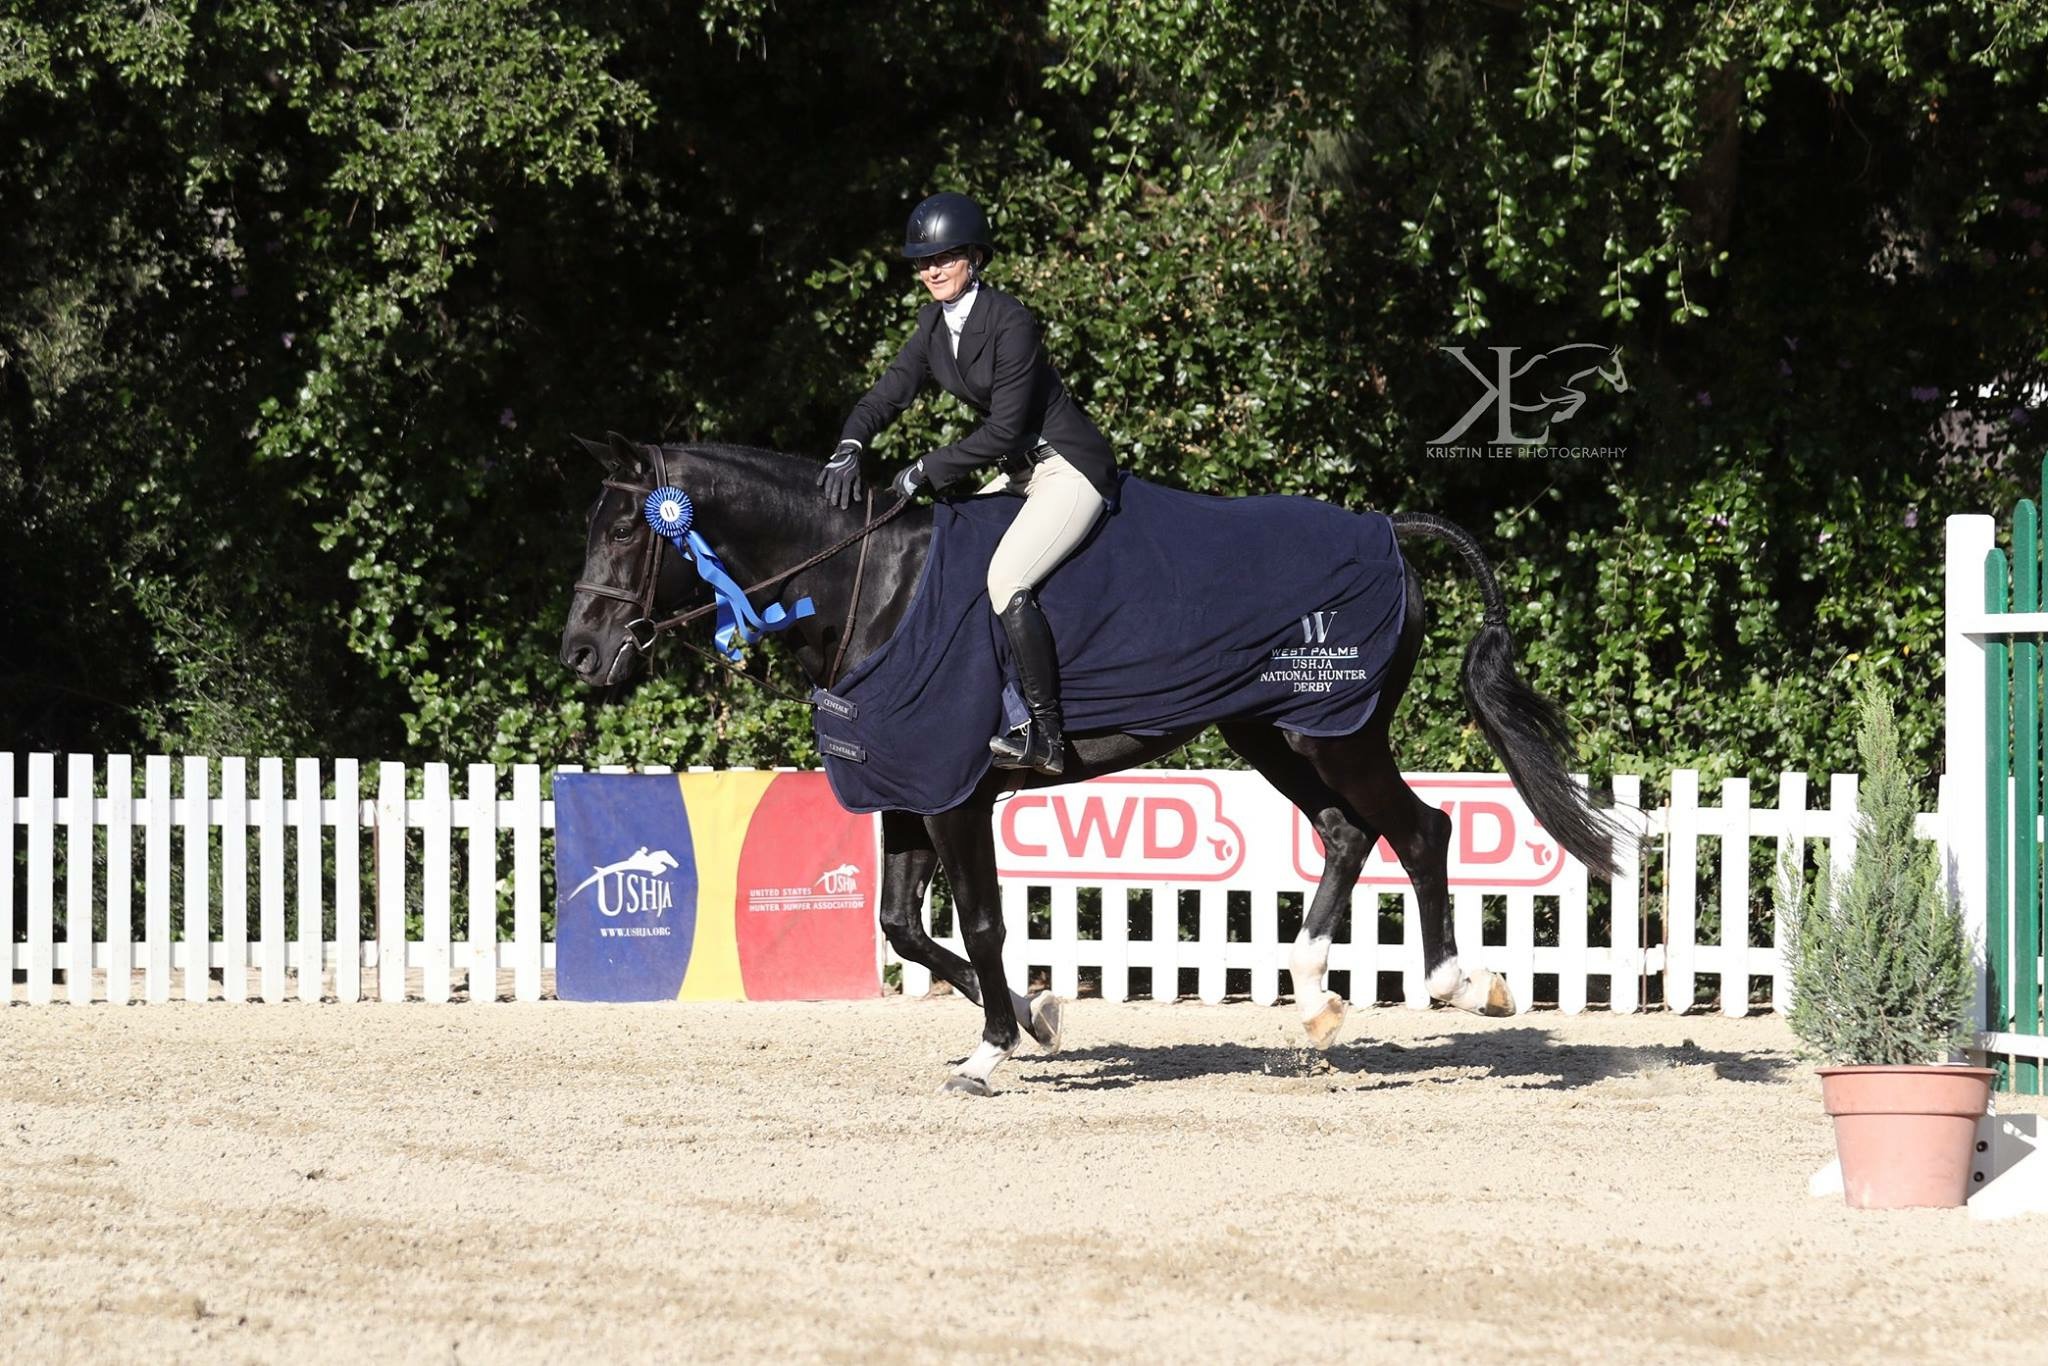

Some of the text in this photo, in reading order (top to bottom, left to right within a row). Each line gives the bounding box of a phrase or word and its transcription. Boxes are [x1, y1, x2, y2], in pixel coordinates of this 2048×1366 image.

[1271, 646, 1359, 657] WEST PALMS
[1292, 659, 1333, 670] USHJA
[1260, 669, 1367, 682] NATIONAL HUNTER
[1293, 682, 1333, 692] DERBY
[1000, 795, 1198, 860] CWD
[597, 868, 673, 918] USHJA
[749, 887, 812, 897] UNITED STATES
[749, 900, 865, 912] HUNTER JUMPER ASSOCIATION
